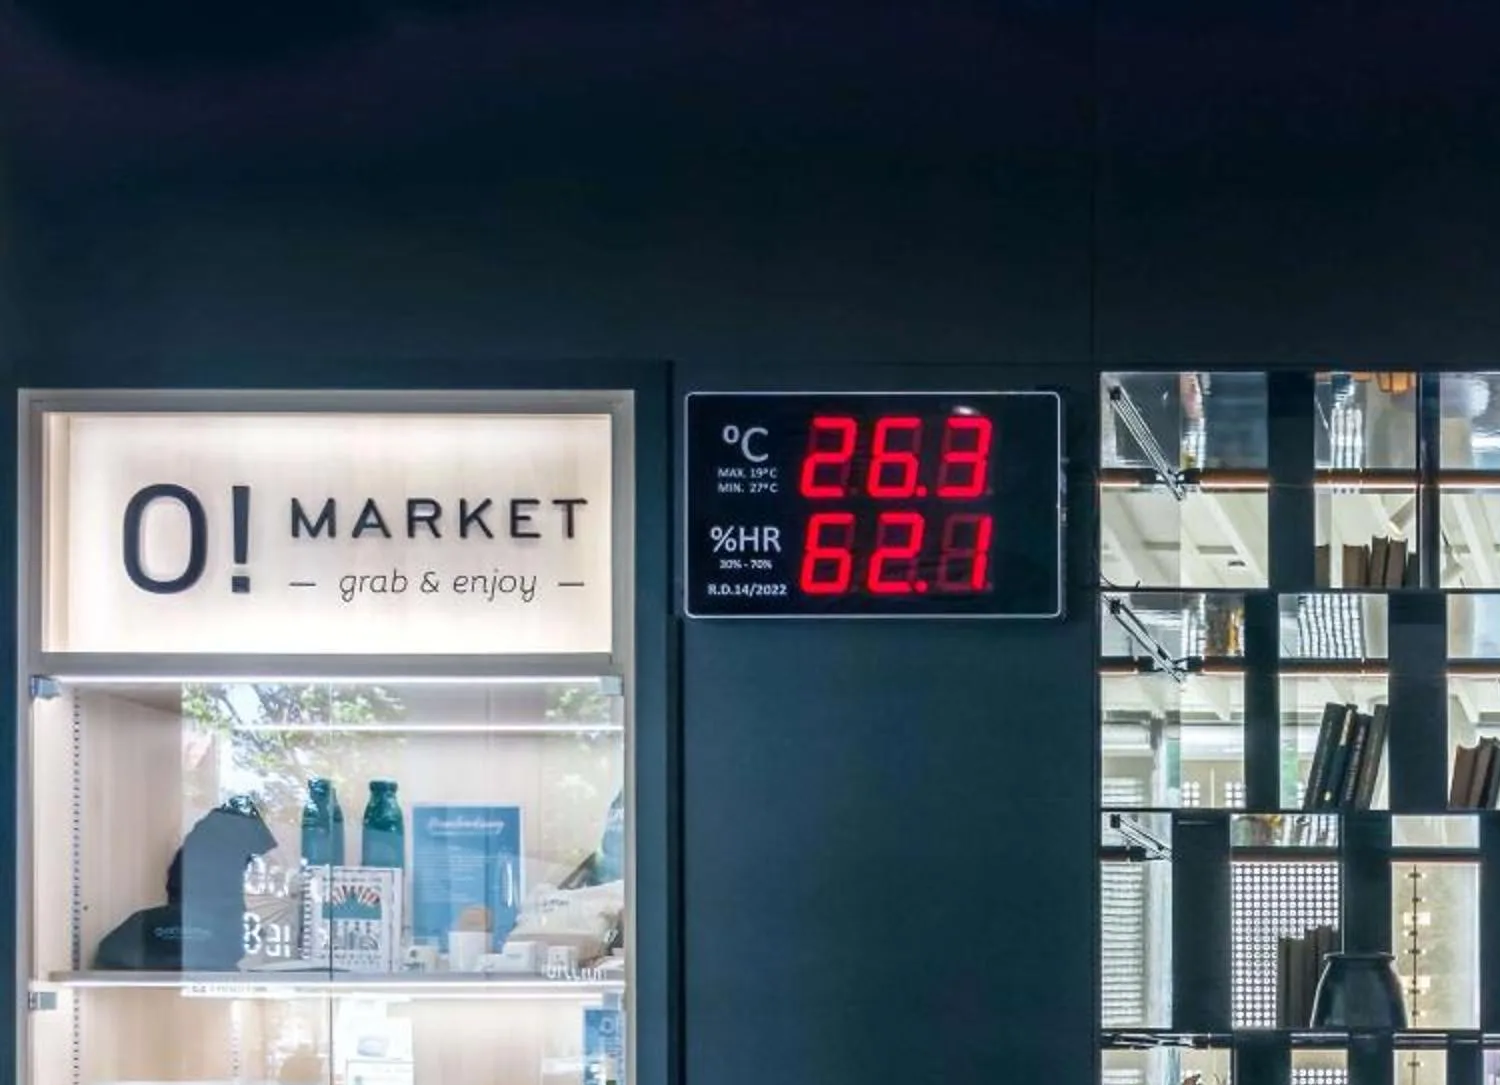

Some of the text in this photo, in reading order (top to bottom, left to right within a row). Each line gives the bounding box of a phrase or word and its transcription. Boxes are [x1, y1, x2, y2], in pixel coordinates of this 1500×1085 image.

[801, 416, 992, 497] 26.3
[123, 483, 588, 594] O! MARKET
[709, 524, 782, 553] %HR
[801, 513, 992, 593] 62.1
[338, 567, 538, 603] grab & enjoy
